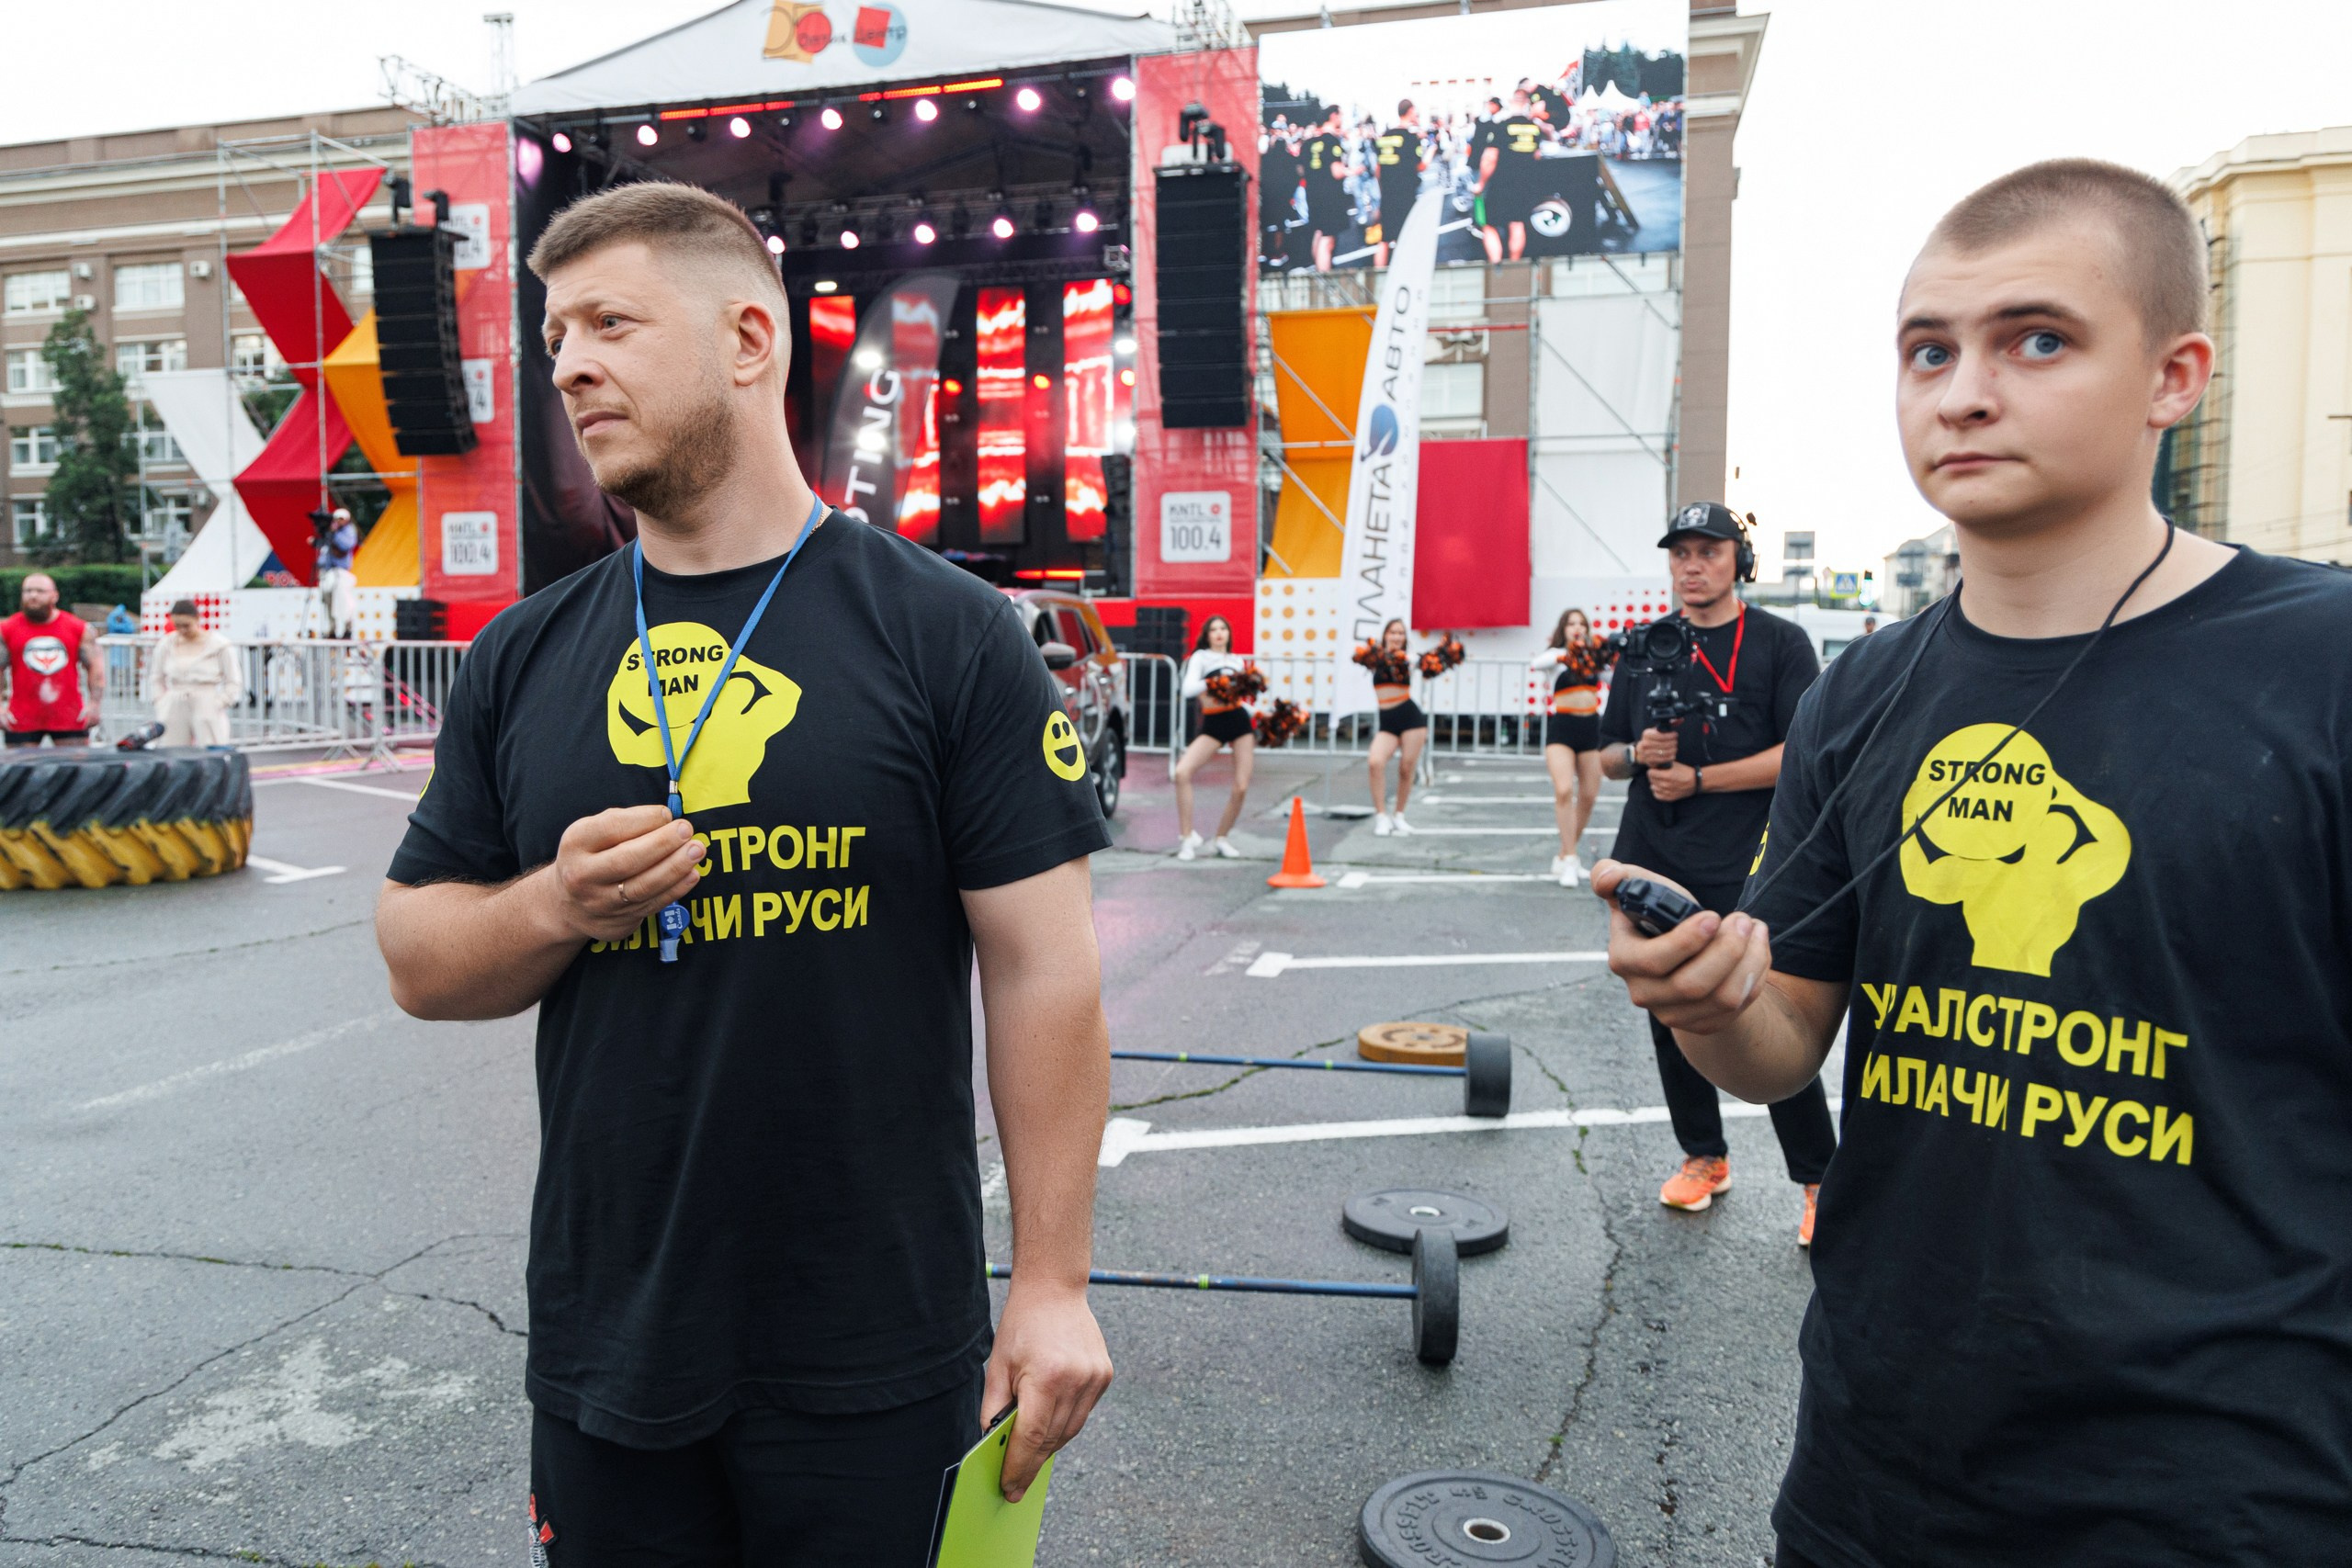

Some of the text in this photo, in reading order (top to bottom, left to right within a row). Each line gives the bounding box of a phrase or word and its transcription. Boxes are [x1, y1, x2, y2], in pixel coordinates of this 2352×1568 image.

[843, 368, 901, 524] TING
[1353, 286, 1410, 641] ПЛАНЕТА АВТО
[1170, 525, 1221, 550] 100.4
[627, 645, 724, 671] SRONG
[1928, 760, 2047, 785] STRONG
[1947, 796, 2014, 822] MAN
[675, 908, 684, 930] Canada
[752, 885, 870, 937] РУСИ
[2021, 1082, 2194, 1166] РУСИ
